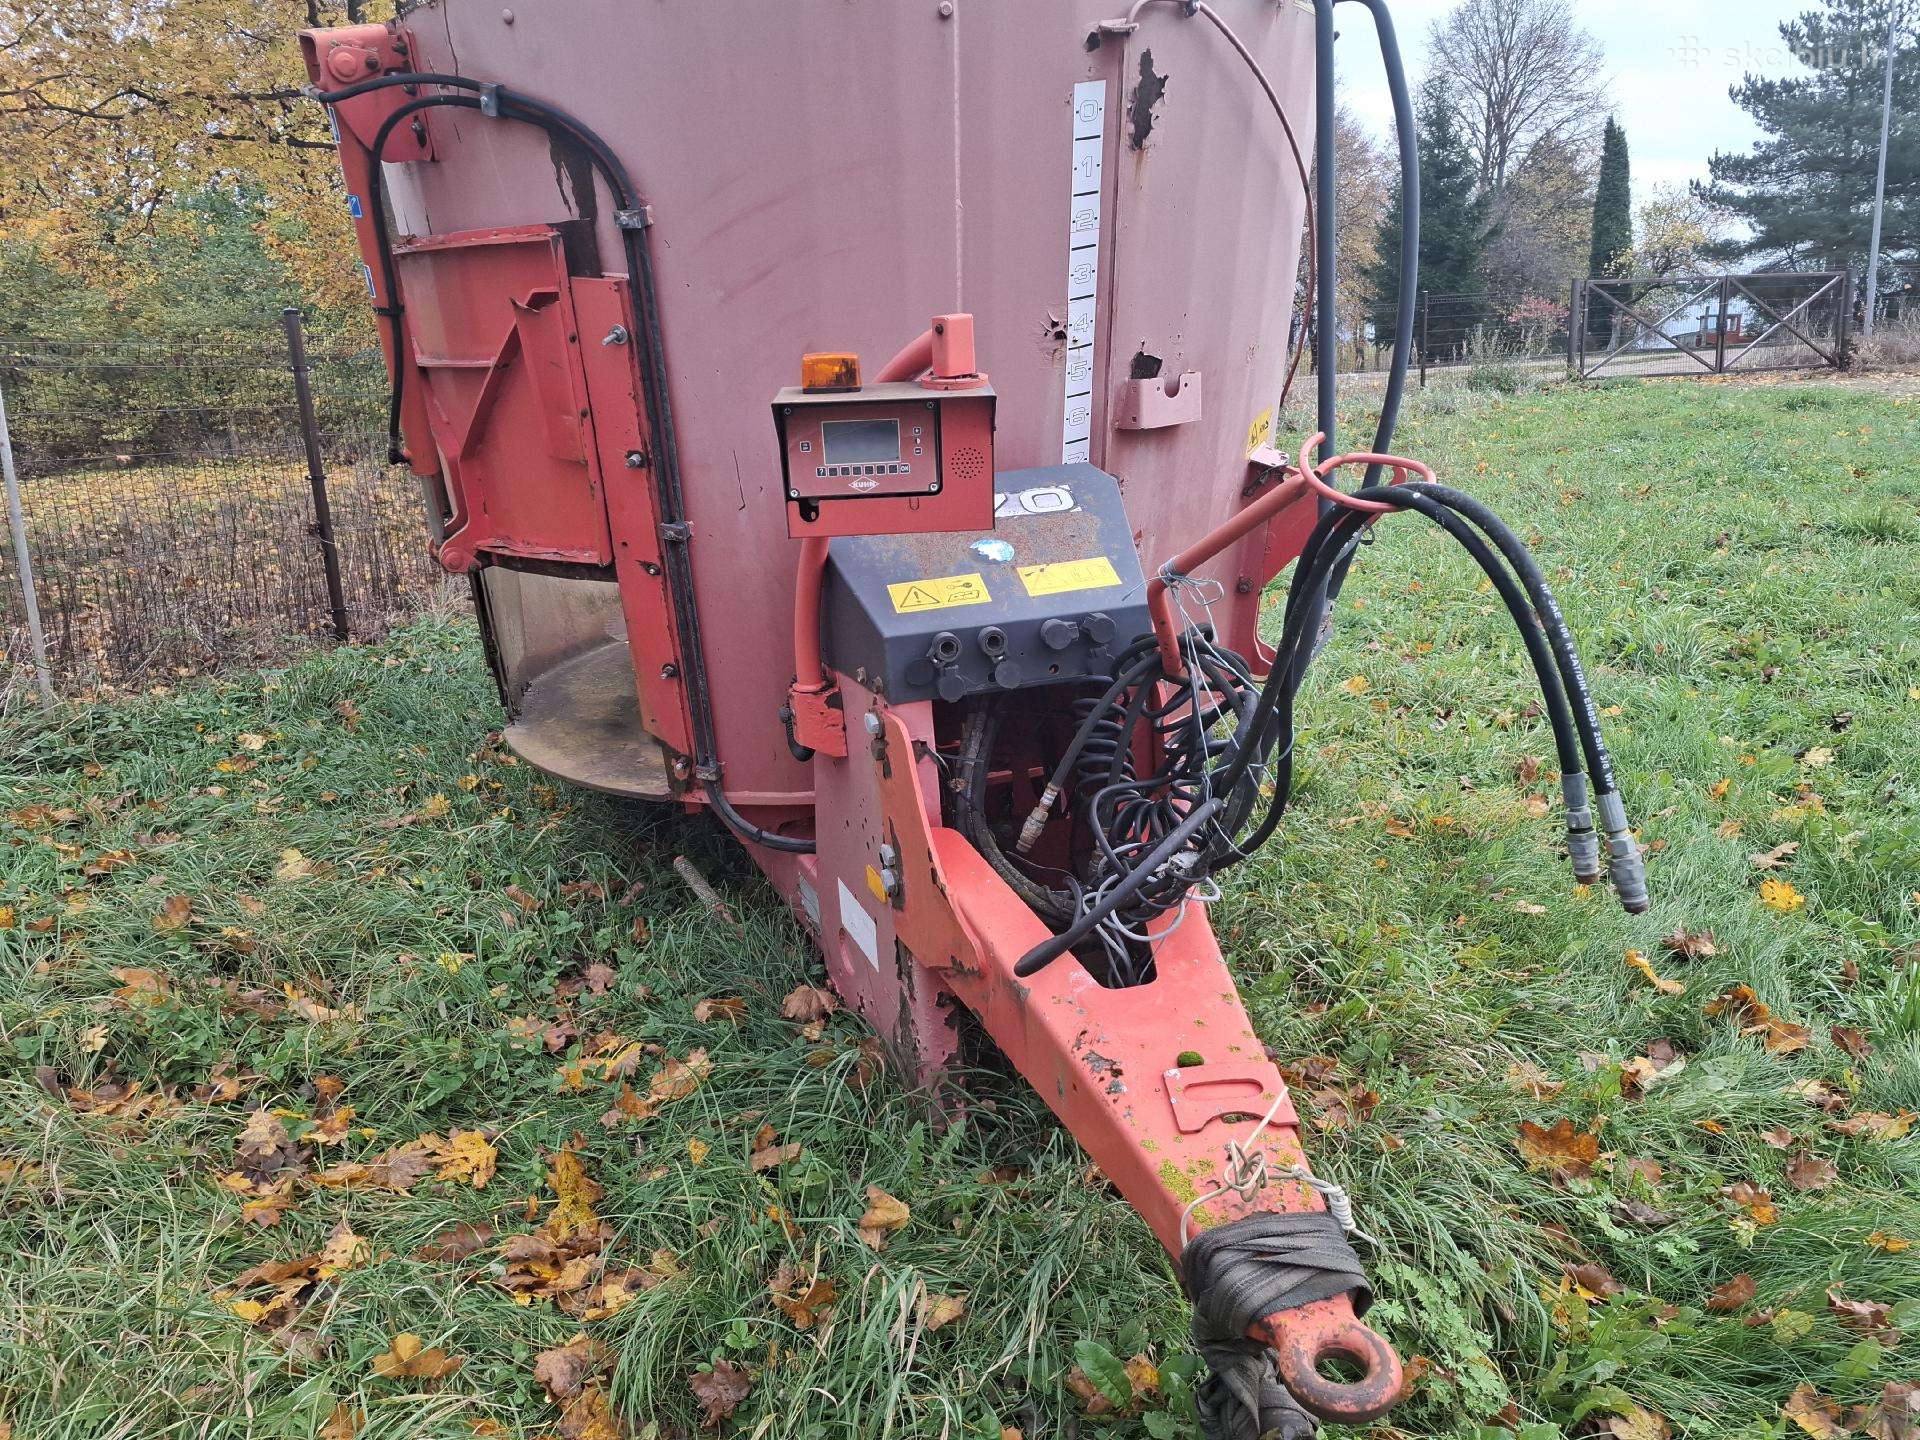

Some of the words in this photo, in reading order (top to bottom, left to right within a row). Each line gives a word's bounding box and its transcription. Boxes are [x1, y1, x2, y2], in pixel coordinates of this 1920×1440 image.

[1080, 100, 1099, 122] 0
[1081, 156, 1093, 177] 1
[1076, 208, 1095, 231] 2
[1074, 262, 1091, 285] 3
[1073, 313, 1089, 332] 4
[1071, 360, 1088, 381] 5
[1068, 407, 1086, 426] 6
